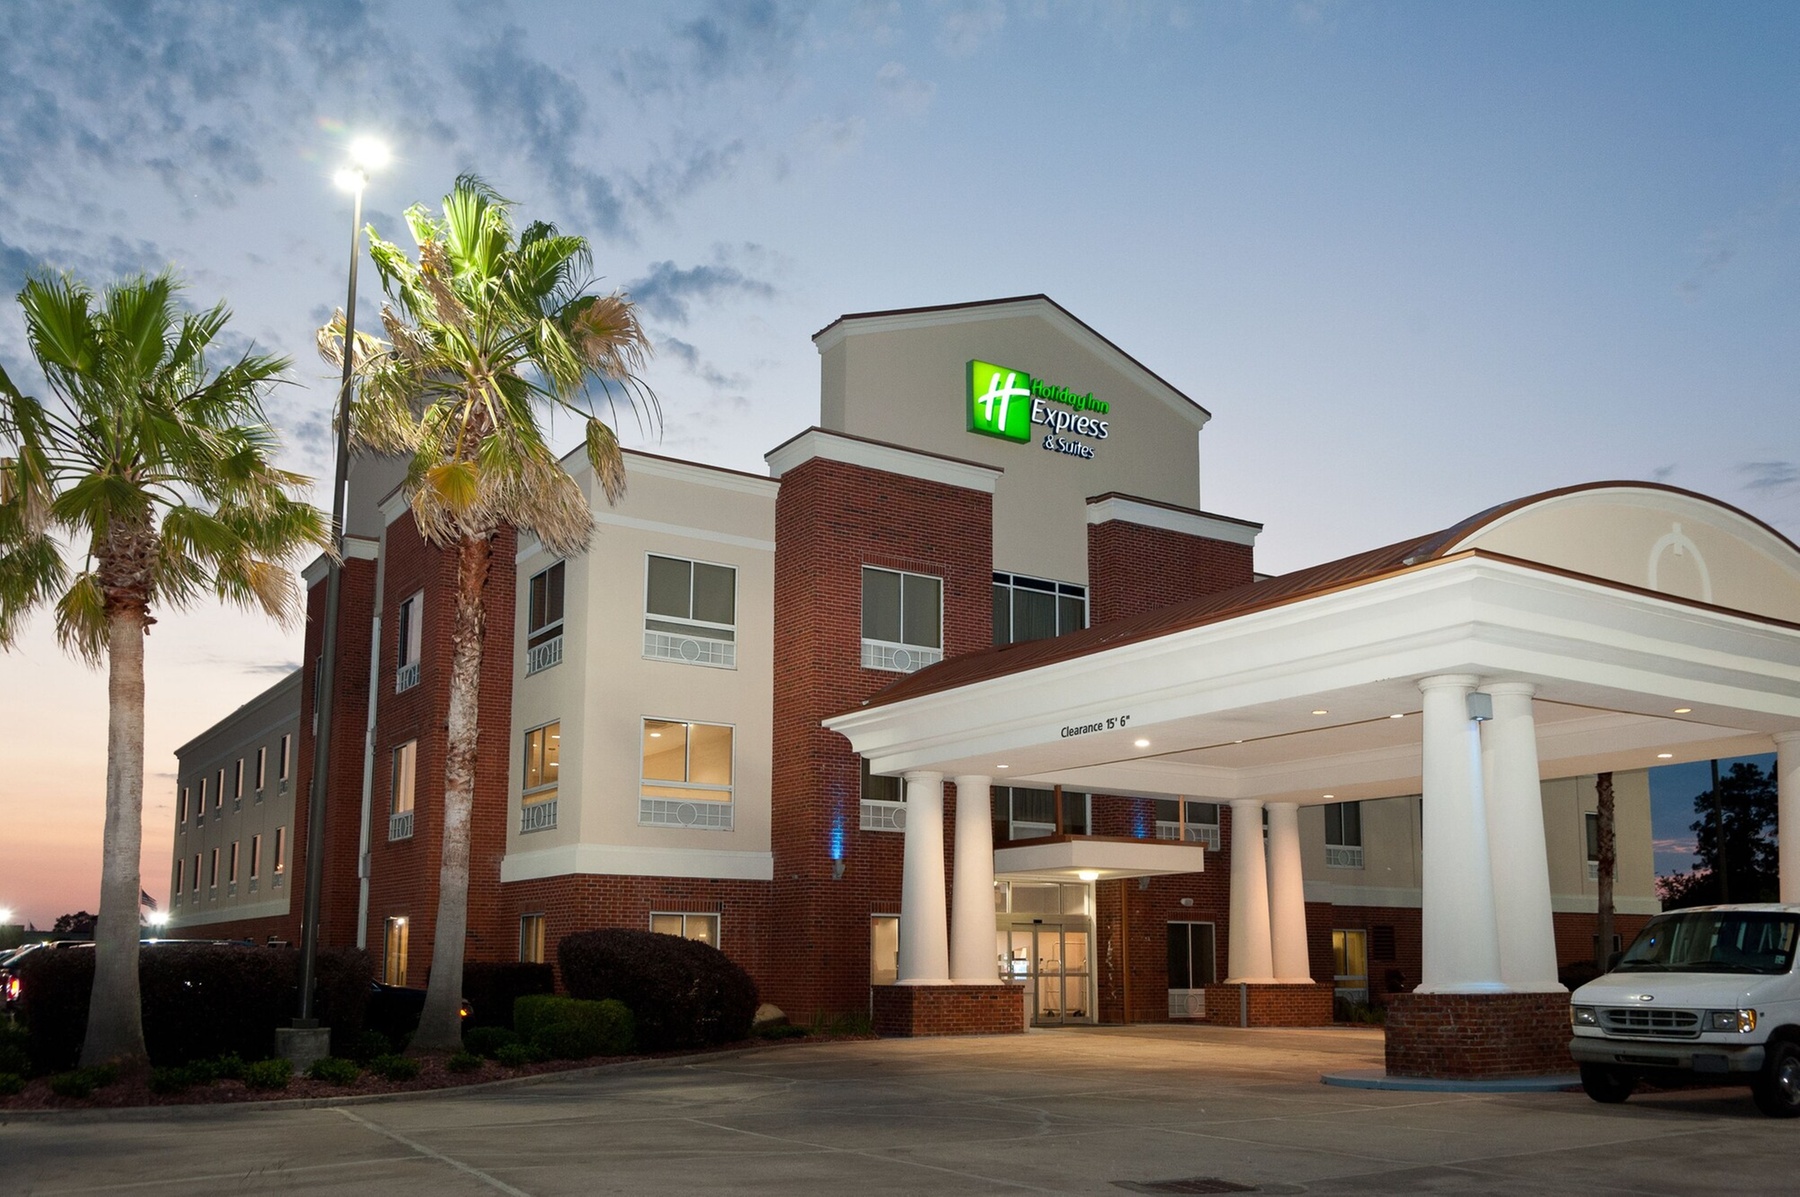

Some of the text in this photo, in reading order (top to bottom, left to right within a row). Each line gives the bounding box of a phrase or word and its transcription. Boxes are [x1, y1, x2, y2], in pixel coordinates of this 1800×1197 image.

[1030, 378, 1109, 414] Holiday Inn
[1031, 398, 1110, 439] Express
[1044, 434, 1096, 459] & Suites
[1061, 722, 1103, 738] Clearance
[1106, 718, 1118, 729] 15'
